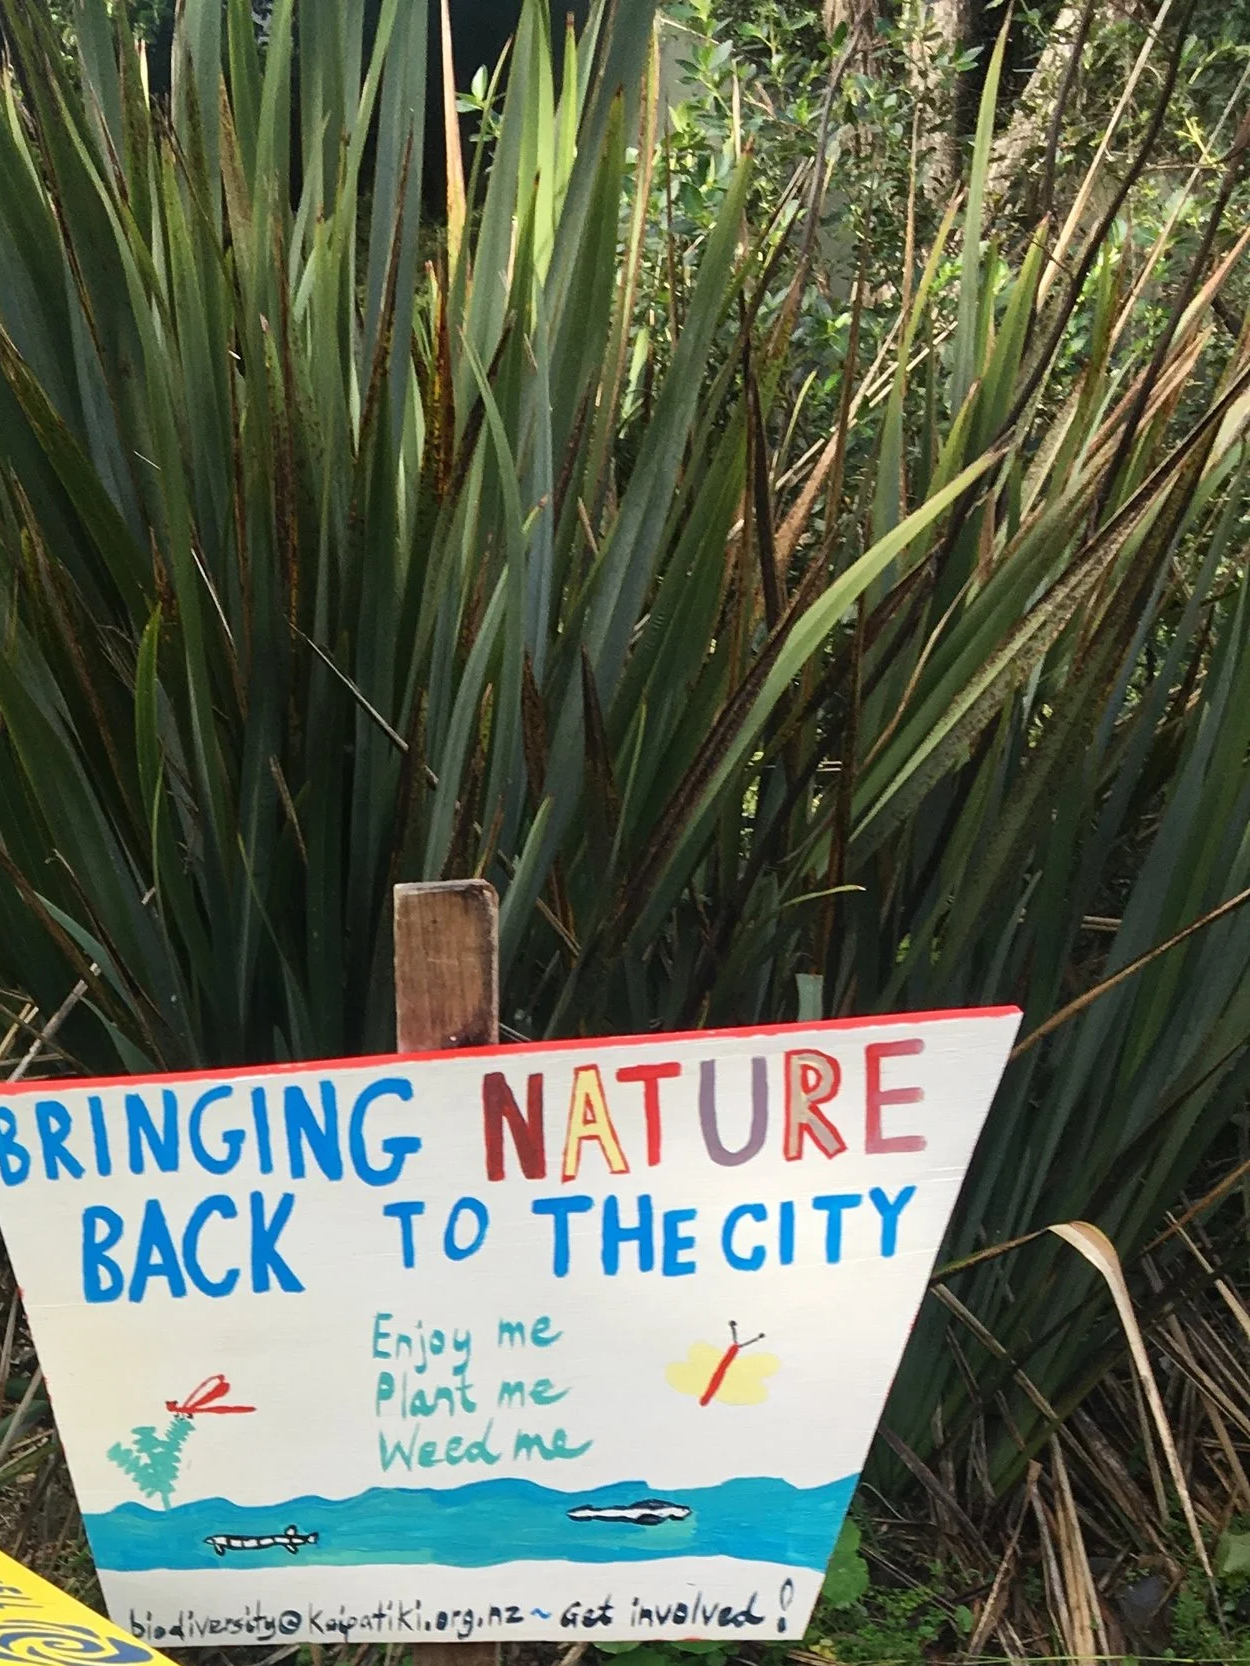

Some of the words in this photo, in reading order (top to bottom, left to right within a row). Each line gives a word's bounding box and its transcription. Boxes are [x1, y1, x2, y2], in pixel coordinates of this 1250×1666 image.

[482, 1038, 927, 1183] NATURE
[82, 1191, 305, 1303] BACK
[383, 1197, 489, 1269] TO
[531, 1194, 697, 1278] THE
[721, 1186, 917, 1272] CITY
[372, 1312, 471, 1377] Enjoy
[498, 1316, 565, 1348] me
[376, 1371, 477, 1420] Plant
[498, 1378, 575, 1408] me
[379, 1418, 502, 1472] Weed
[513, 1428, 594, 1461] me
[560, 1593, 614, 1629] Get
